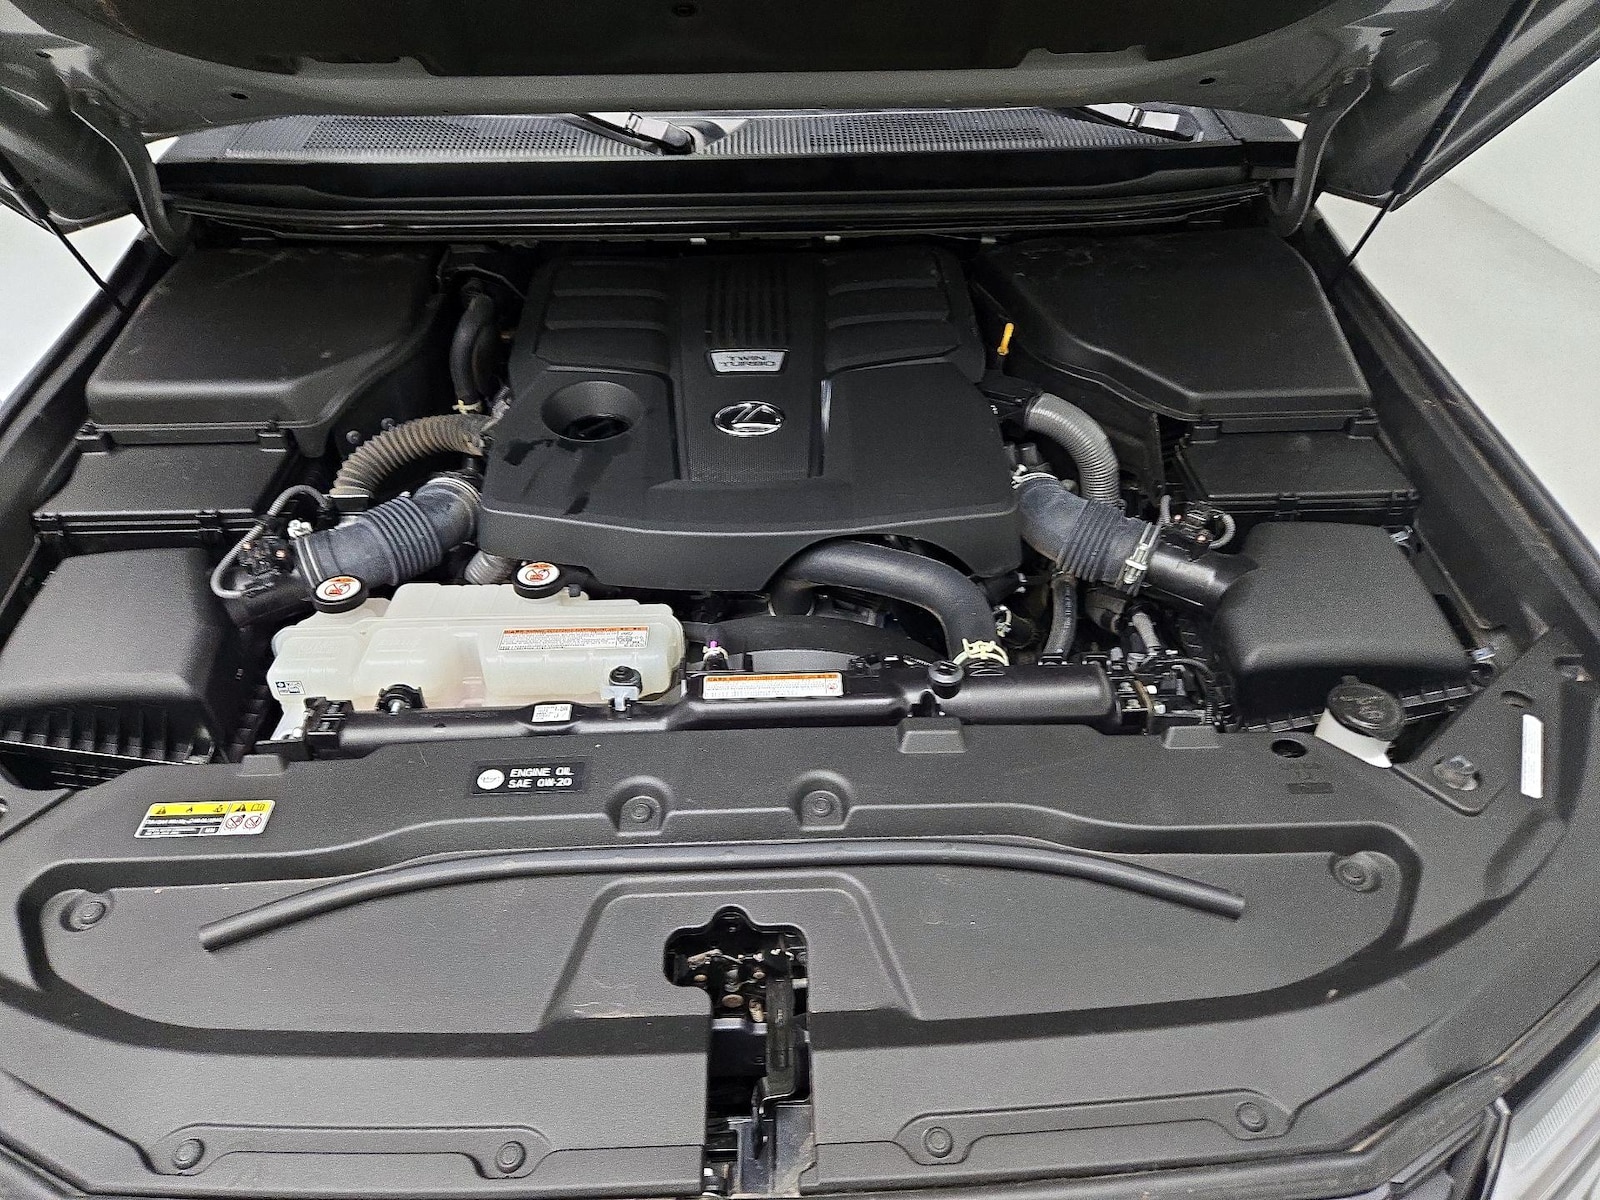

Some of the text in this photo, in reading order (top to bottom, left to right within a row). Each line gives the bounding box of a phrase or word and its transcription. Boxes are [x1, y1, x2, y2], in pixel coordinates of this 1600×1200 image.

[509, 766, 574, 778] ENGINE OIL
[507, 777, 573, 788] SAE 0W-20
